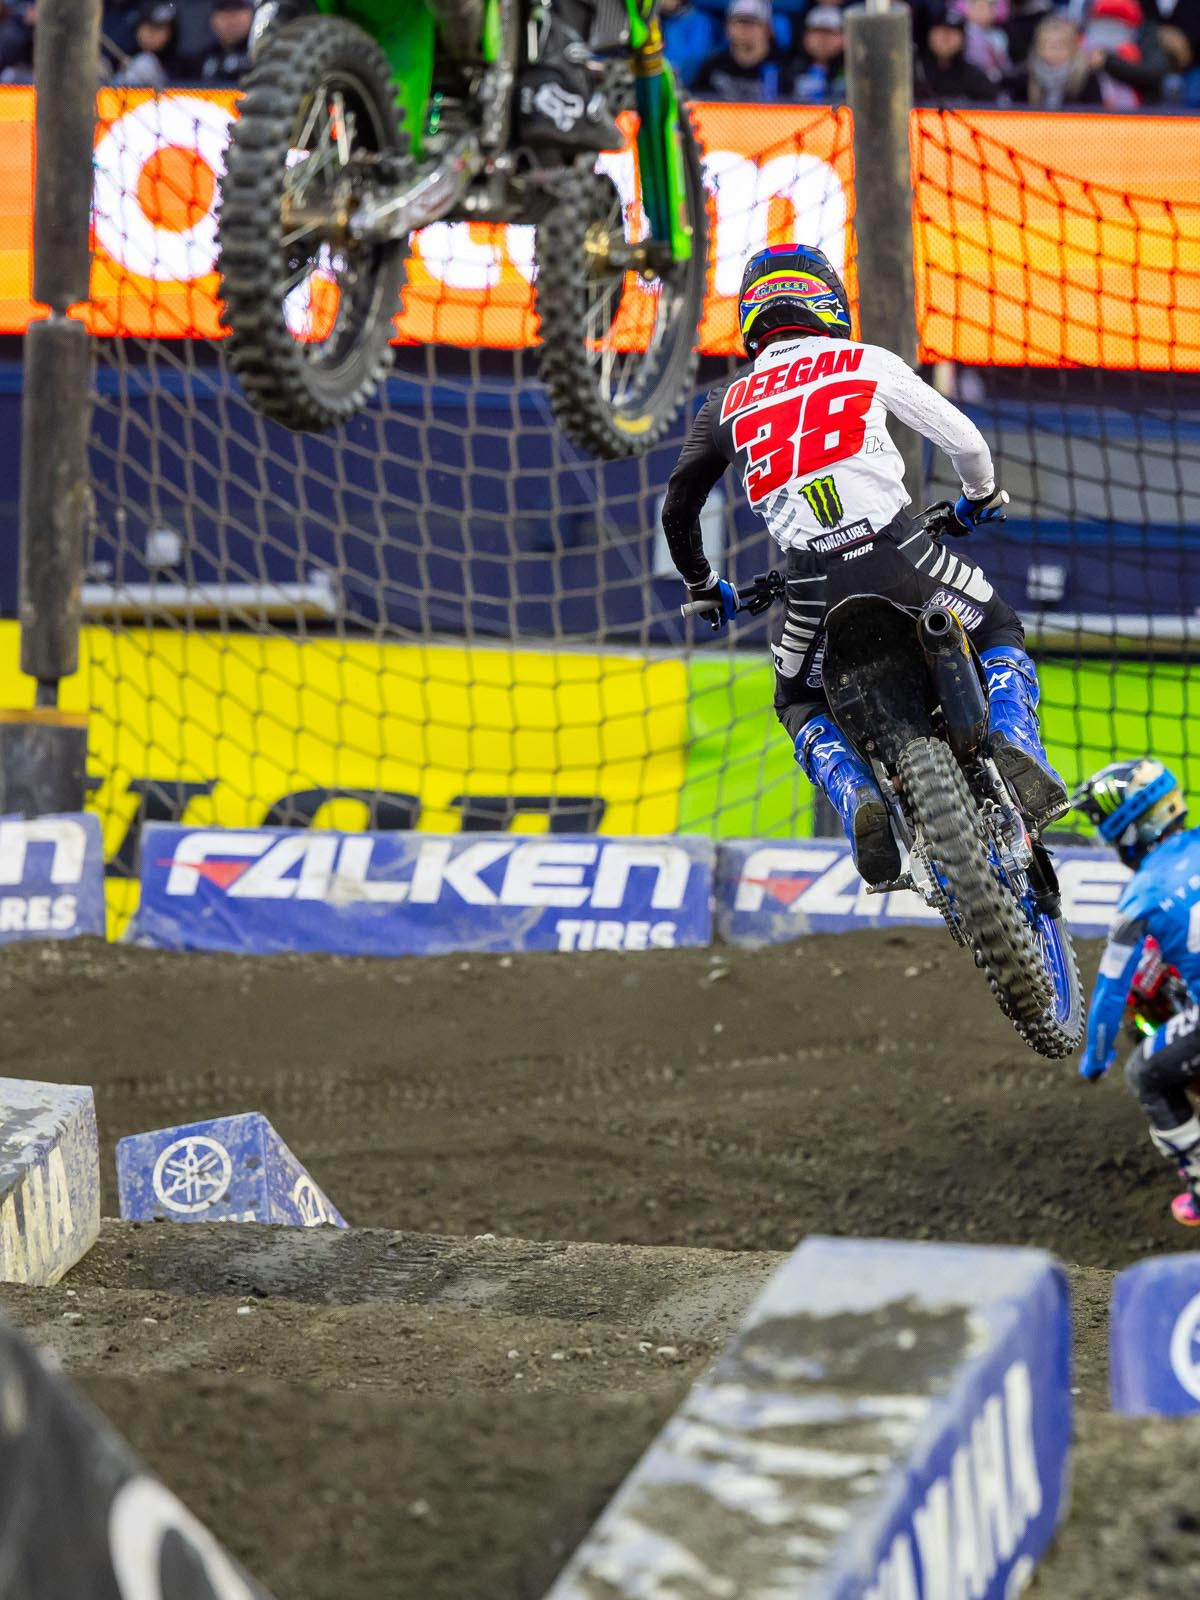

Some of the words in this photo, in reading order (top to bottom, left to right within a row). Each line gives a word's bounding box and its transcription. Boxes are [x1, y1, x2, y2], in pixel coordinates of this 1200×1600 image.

[721, 348, 866, 422] DEEGAN
[733, 379, 878, 504] 38
[811, 522, 871, 553] YAMALUBE
[842, 542, 874, 561] THOR
[166, 827, 692, 909] FALKEN
[555, 919, 677, 952] TIRES
